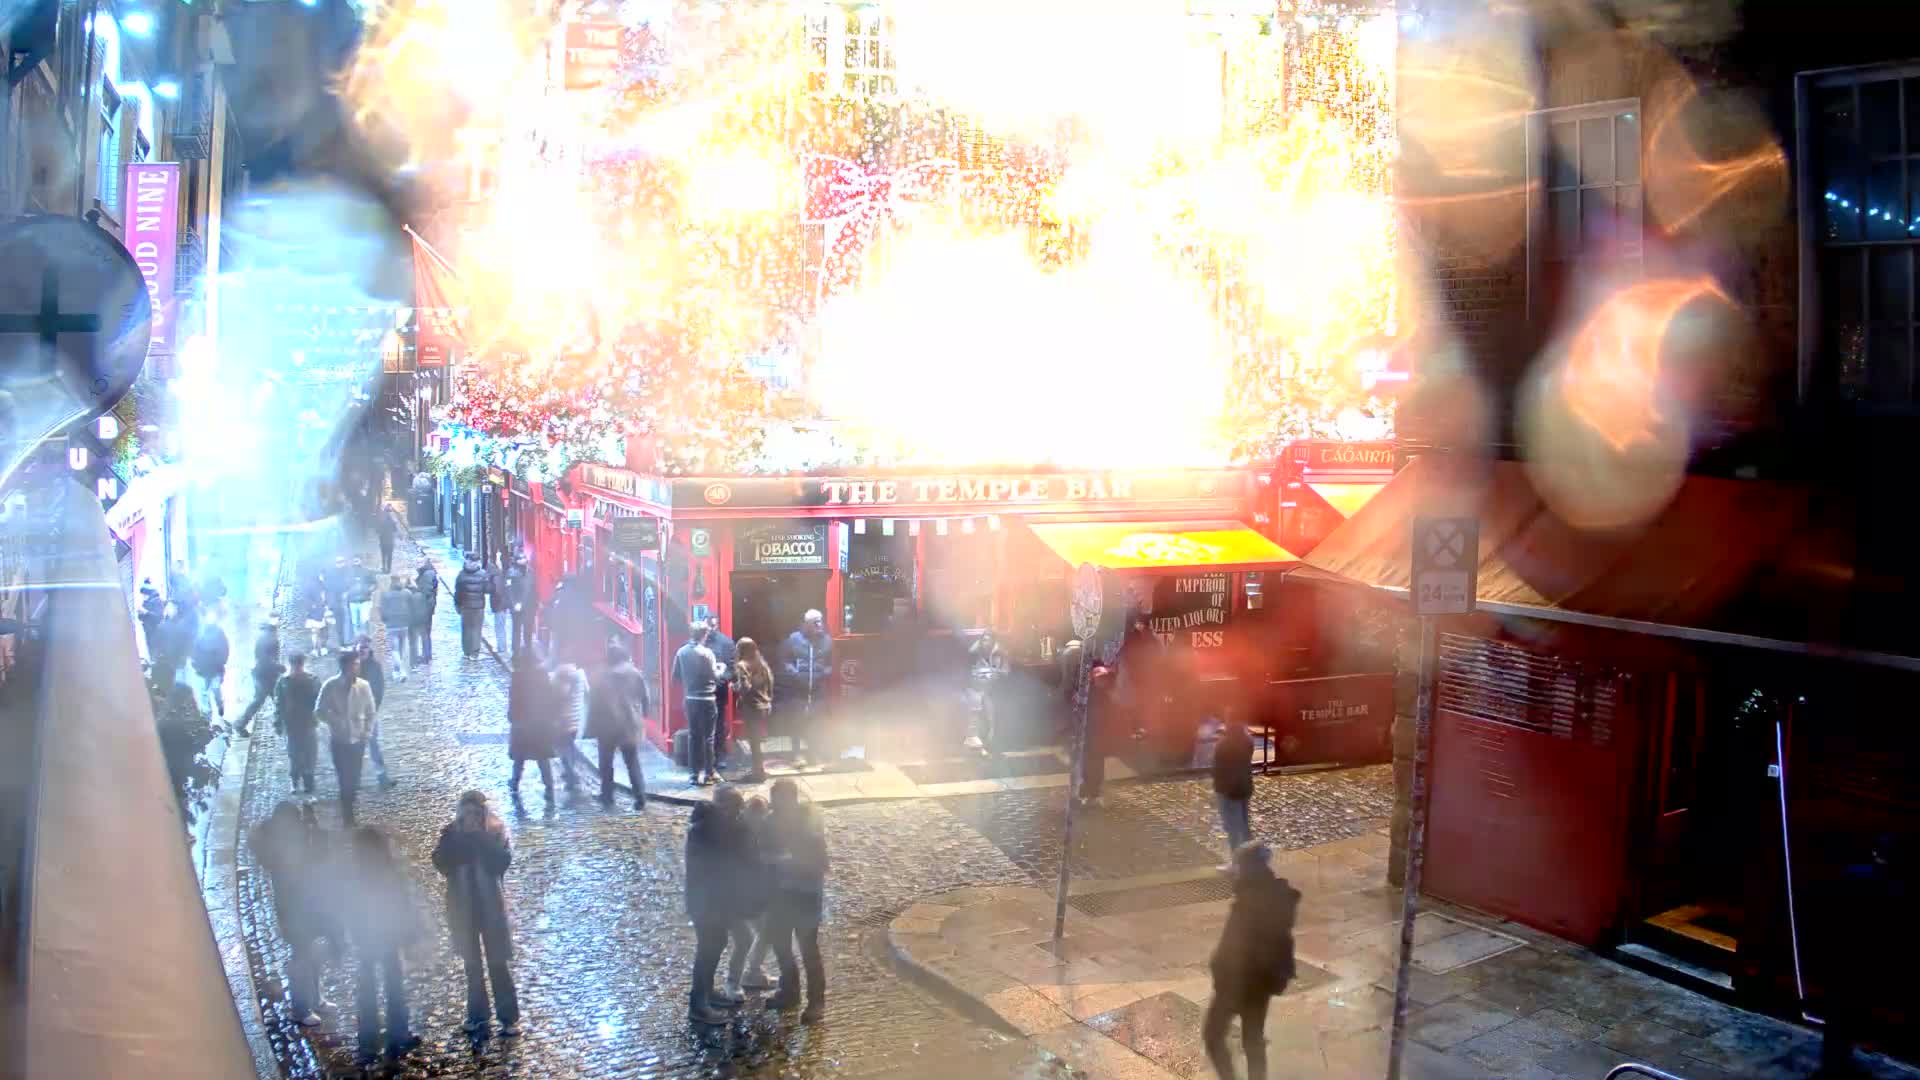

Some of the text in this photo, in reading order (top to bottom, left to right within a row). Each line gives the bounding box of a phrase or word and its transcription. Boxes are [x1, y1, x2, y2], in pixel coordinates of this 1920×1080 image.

[136, 170, 169, 233] NINE
[820, 477, 1131, 505] THE TEMPLE BAR
[751, 539, 816, 561] TOBACCO
[1175, 578, 1225, 593] EMPEROR
[1211, 593, 1225, 608] OF
[1150, 608, 1226, 633] ALTED LIQUORS
